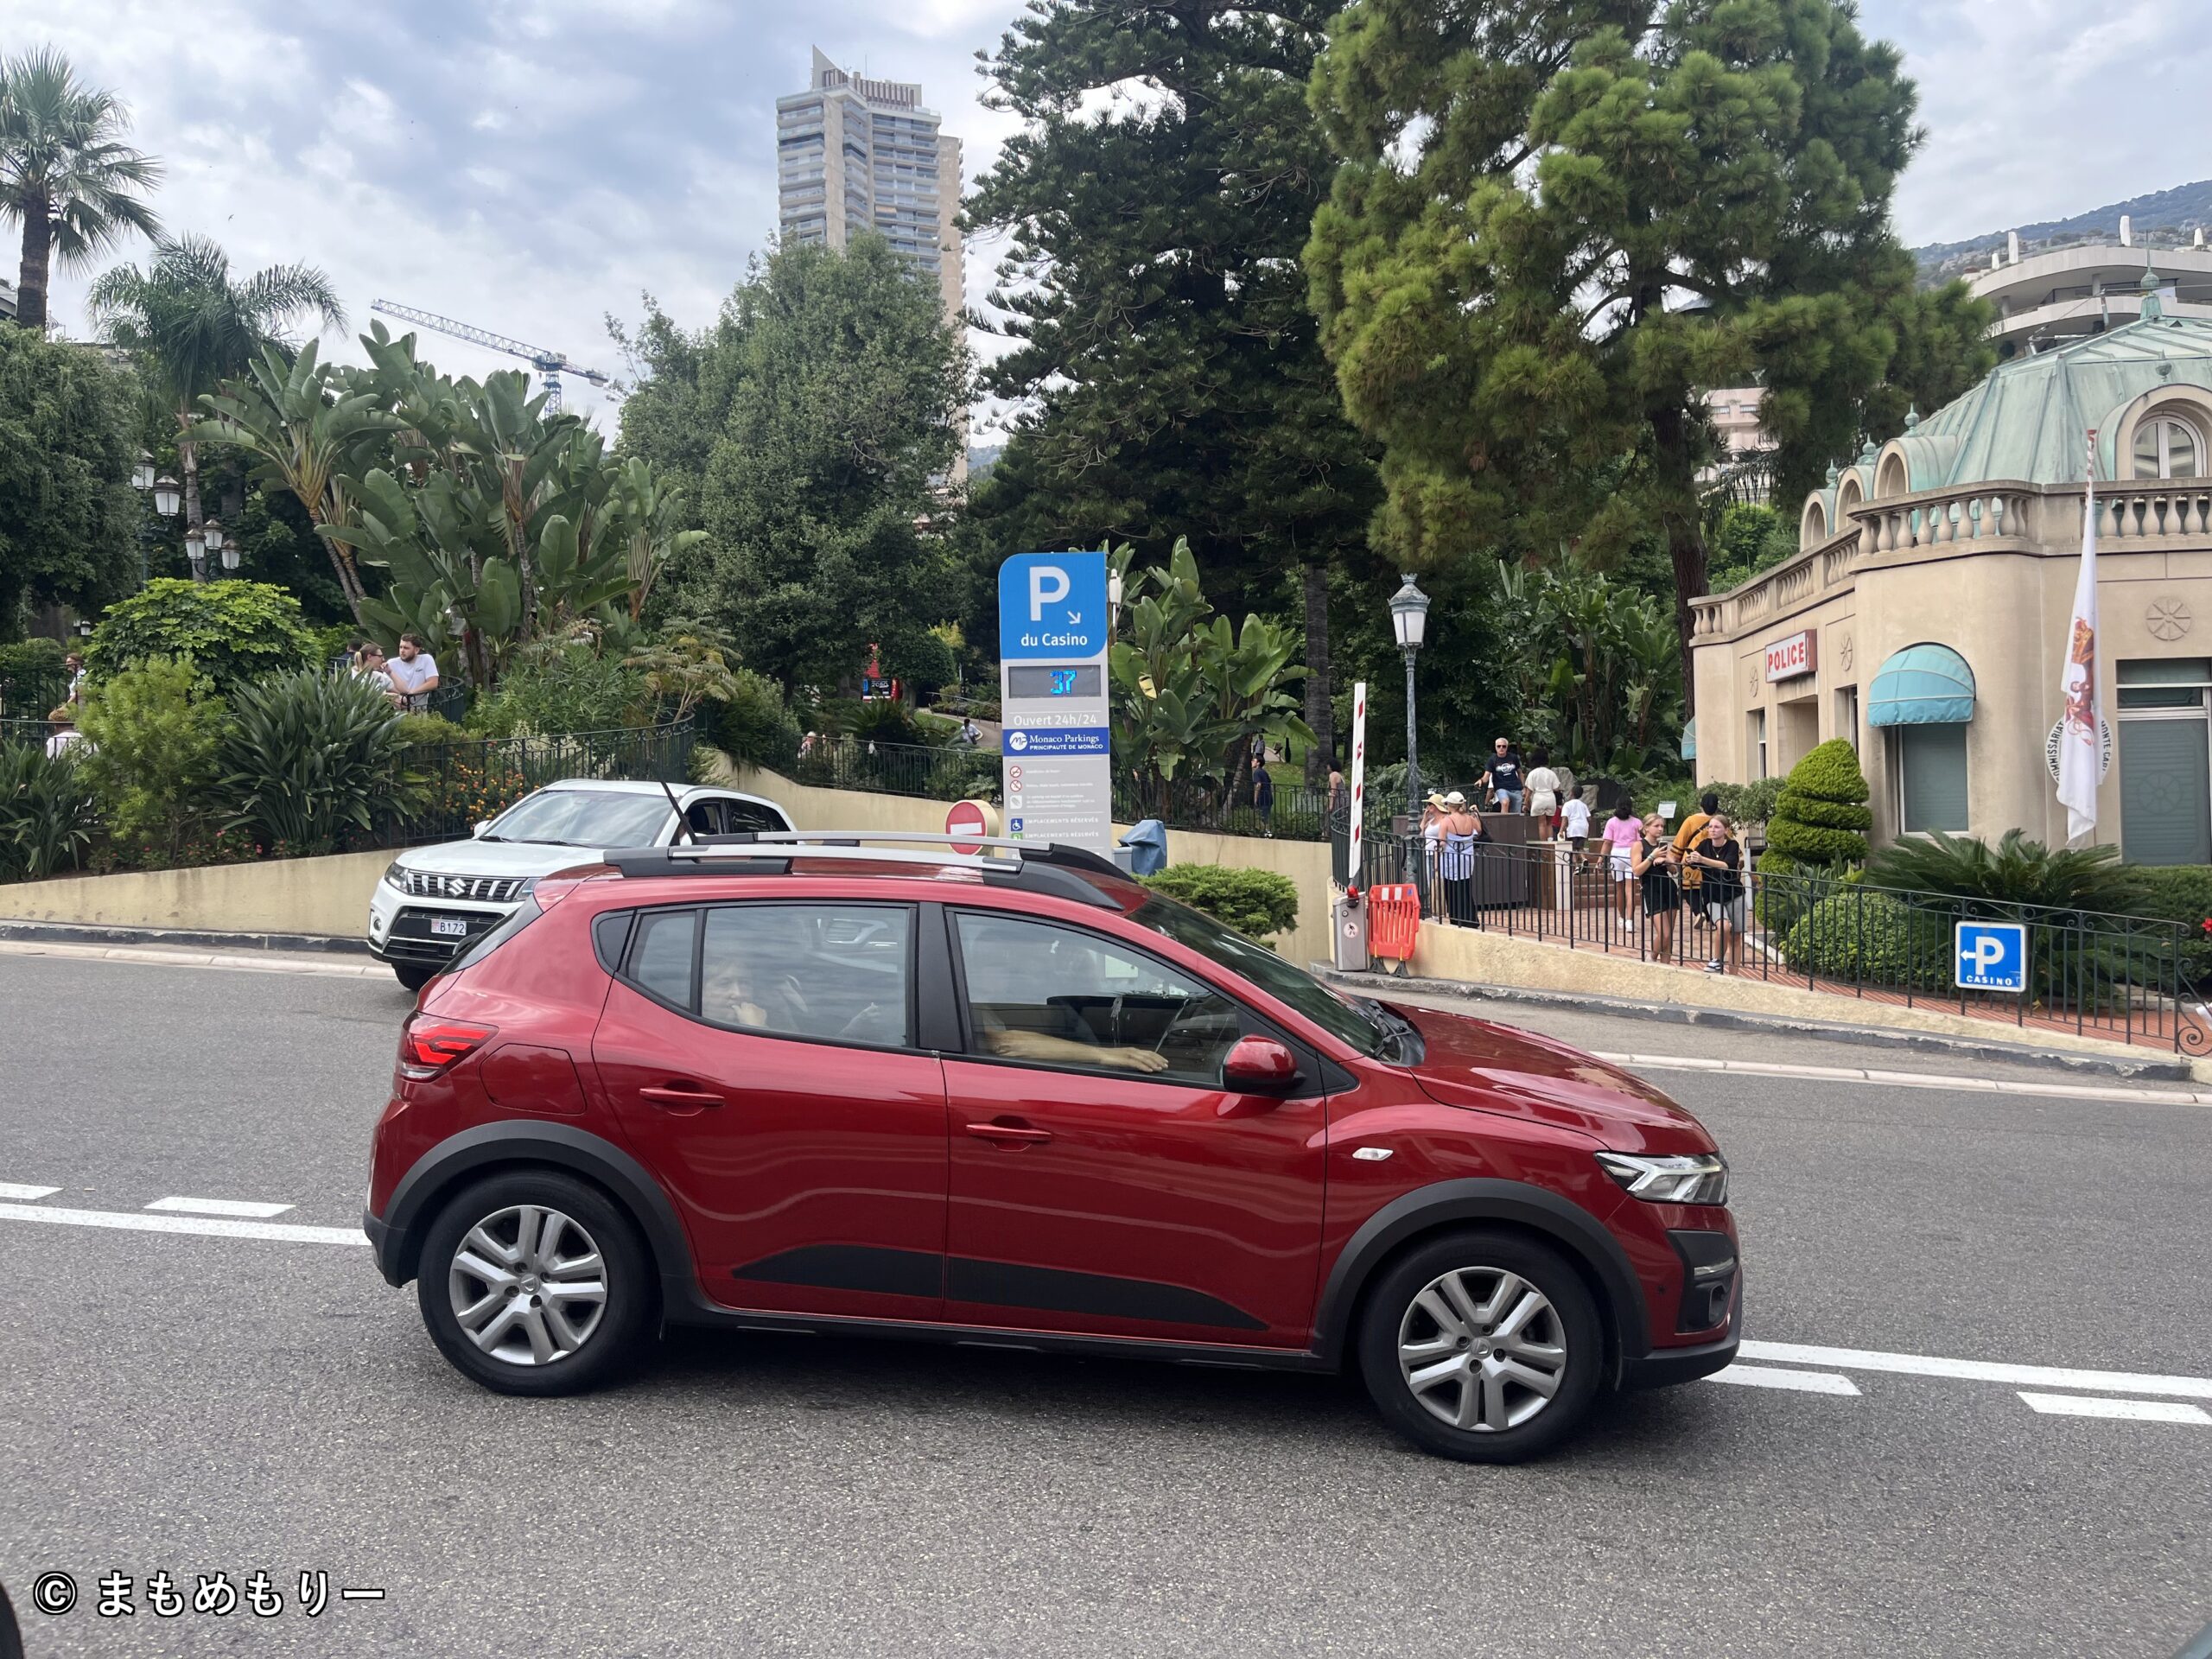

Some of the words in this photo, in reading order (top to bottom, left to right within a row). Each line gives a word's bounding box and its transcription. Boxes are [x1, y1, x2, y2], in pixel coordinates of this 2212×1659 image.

[1029, 566, 1071, 621] P
[1020, 633, 1038, 646] du
[1042, 632, 1088, 646] Casino
[1768, 642, 1804, 674] POLICE
[1050, 670, 1077, 695] 37
[1014, 715, 1052, 727] Ouvert
[1056, 714, 1096, 726] 24h/24
[1029, 734, 1063, 743] Monaco
[1065, 734, 1100, 745] Parkings
[441, 922, 465, 934] B172
[1975, 936, 2005, 976] P
[1966, 975, 2012, 986] CASINO
